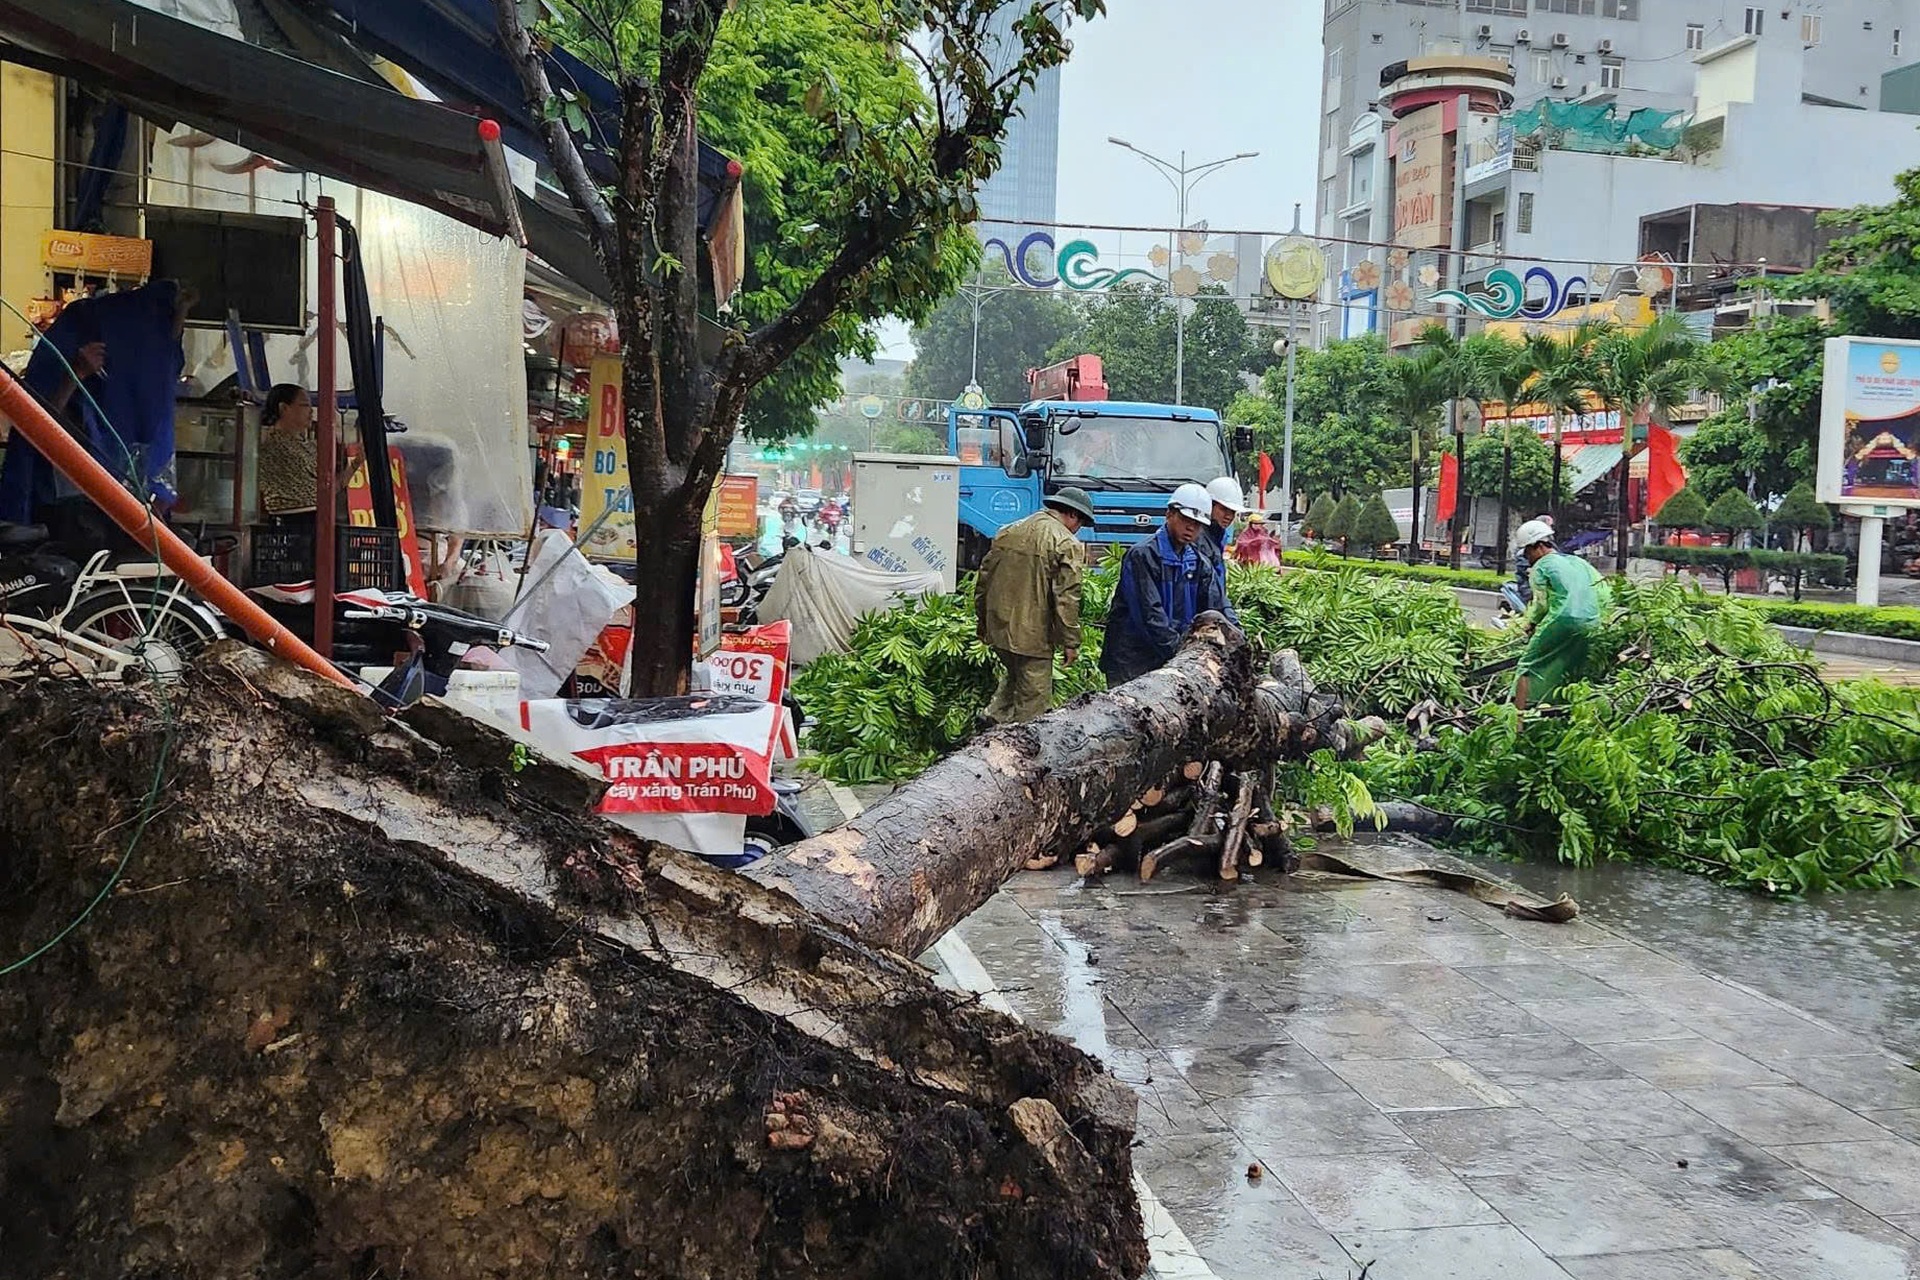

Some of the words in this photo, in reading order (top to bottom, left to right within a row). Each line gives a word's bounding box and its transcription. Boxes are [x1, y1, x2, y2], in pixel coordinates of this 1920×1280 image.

[594, 445, 616, 475] BÒ
[609, 749, 682, 779] TRẦN
[689, 752, 746, 780] PHÚ
[641, 783, 682, 800] xăng
[685, 782, 720, 797] Trần
[724, 783, 757, 801] Phú)
